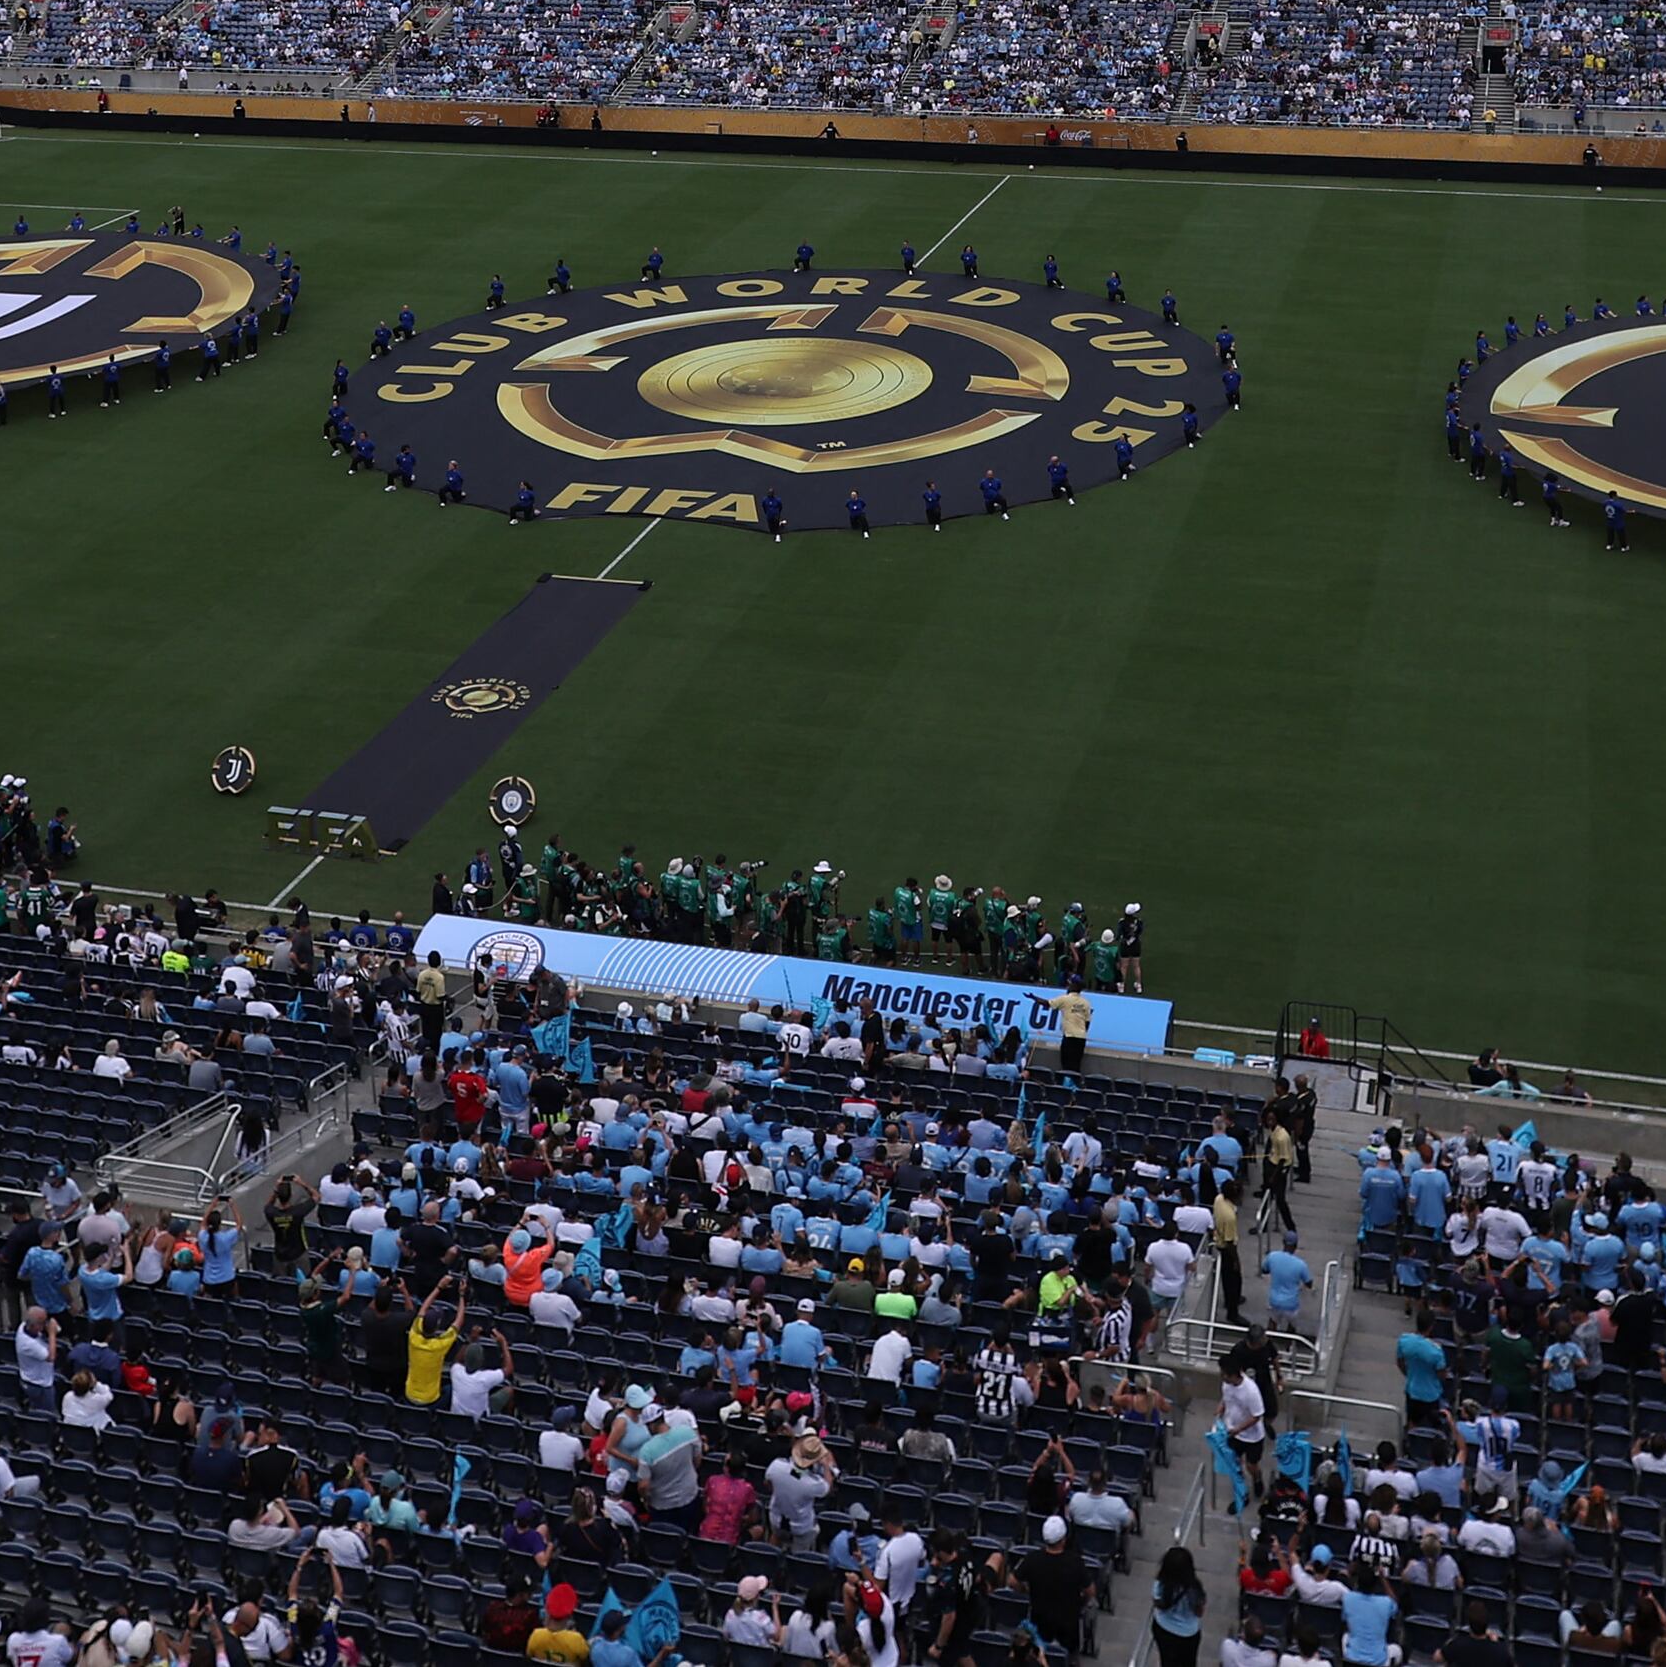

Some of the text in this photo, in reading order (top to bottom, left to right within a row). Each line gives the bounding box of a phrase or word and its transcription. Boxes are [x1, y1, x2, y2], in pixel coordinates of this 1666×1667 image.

[376, 277, 1189, 445] CLUB WORLD CUP 25
[545, 482, 759, 523] FIFA
[266, 806, 380, 861] FIFA
[27, 900, 41, 916] 41
[821, 974, 1020, 1024] Manchester
[456, 1082, 468, 1097] 5
[1495, 1153, 1512, 1172] 21
[1534, 1176, 1543, 1193] 8
[1460, 1228, 1471, 1244] 7
[1559, 1355, 1569, 1371] 9
[983, 1371, 1006, 1399] 21
